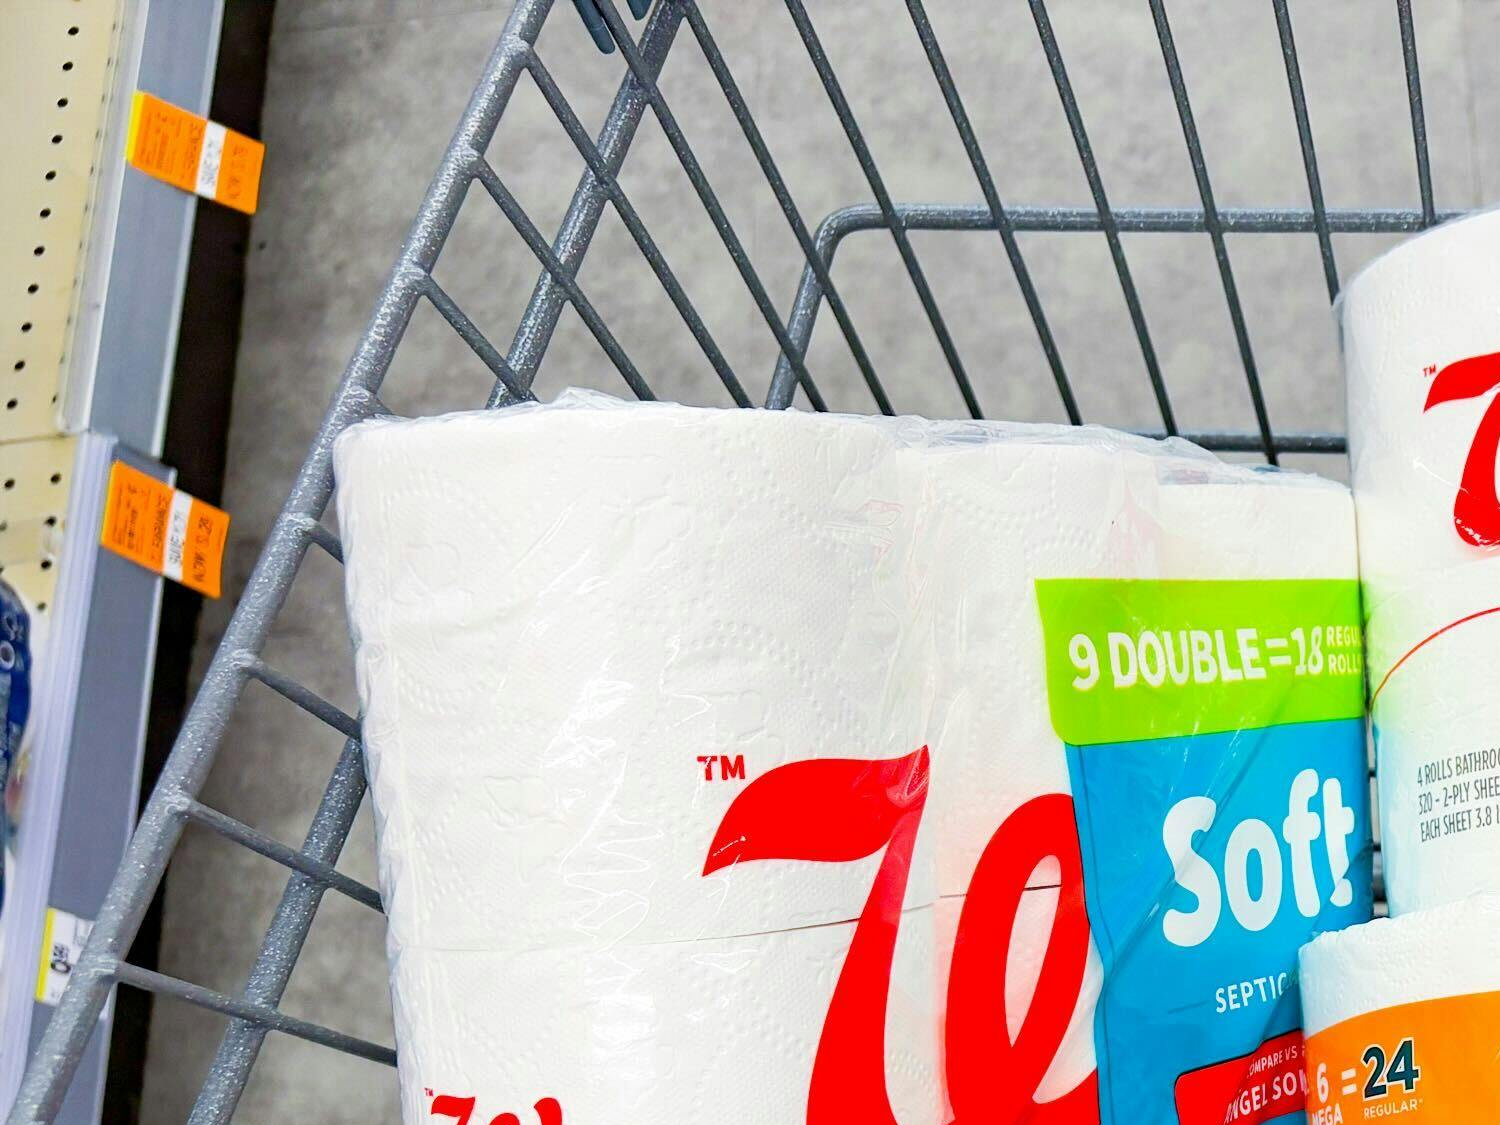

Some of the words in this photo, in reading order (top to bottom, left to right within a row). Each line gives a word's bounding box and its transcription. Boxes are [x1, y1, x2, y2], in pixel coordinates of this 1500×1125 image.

[1069, 632, 1100, 690] 9
[1417, 767, 1423, 787] 4
[1425, 757, 1452, 785] ROLLS
[1418, 792, 1433, 815] 320
[1443, 782, 1471, 807] 2-PLY
[1421, 817, 1441, 843] EACH
[1443, 809, 1472, 835] SHEET
[1475, 806, 1492, 828] 3.8
[1162, 768, 1355, 947] Soft
[1247, 1050, 1283, 1078] OMPARE
[1285, 1045, 1298, 1060] VS
[1316, 1062, 1329, 1104] 6
[1360, 1036, 1421, 1101] 24
